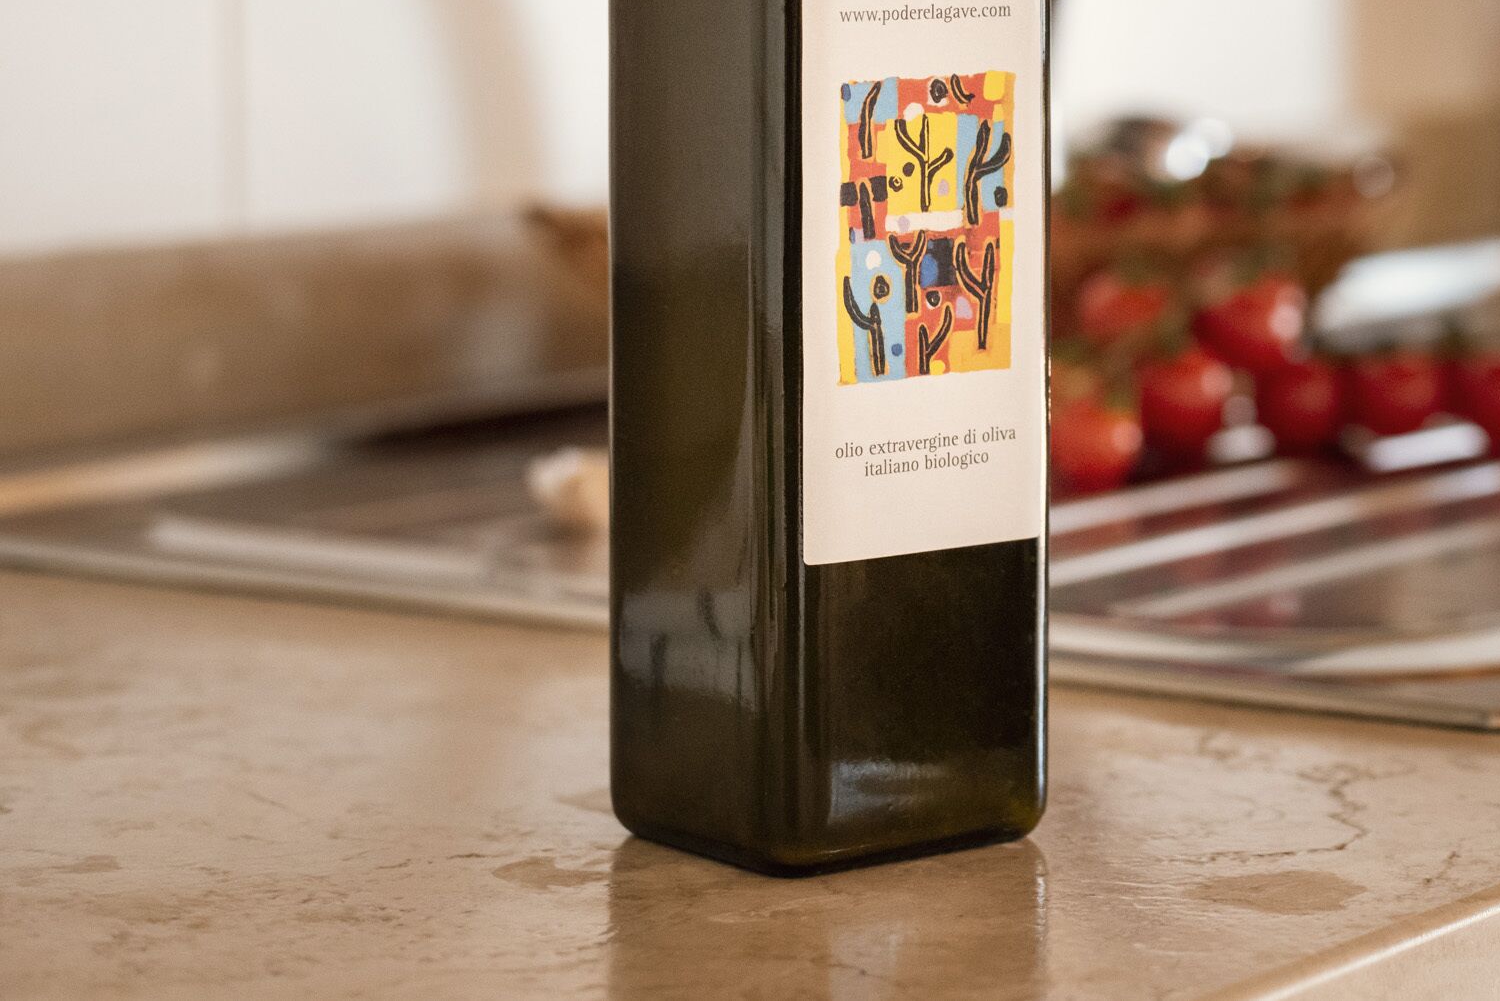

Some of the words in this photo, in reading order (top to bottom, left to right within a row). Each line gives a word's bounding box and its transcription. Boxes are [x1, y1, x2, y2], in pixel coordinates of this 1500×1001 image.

[839, 4, 1011, 25] www.poderelagave.com
[835, 442, 864, 459] olio
[869, 433, 959, 453] extravergine
[963, 429, 977, 445] di
[981, 427, 1016, 443] oliva
[864, 459, 919, 477] italiano
[924, 450, 989, 470] biologico
